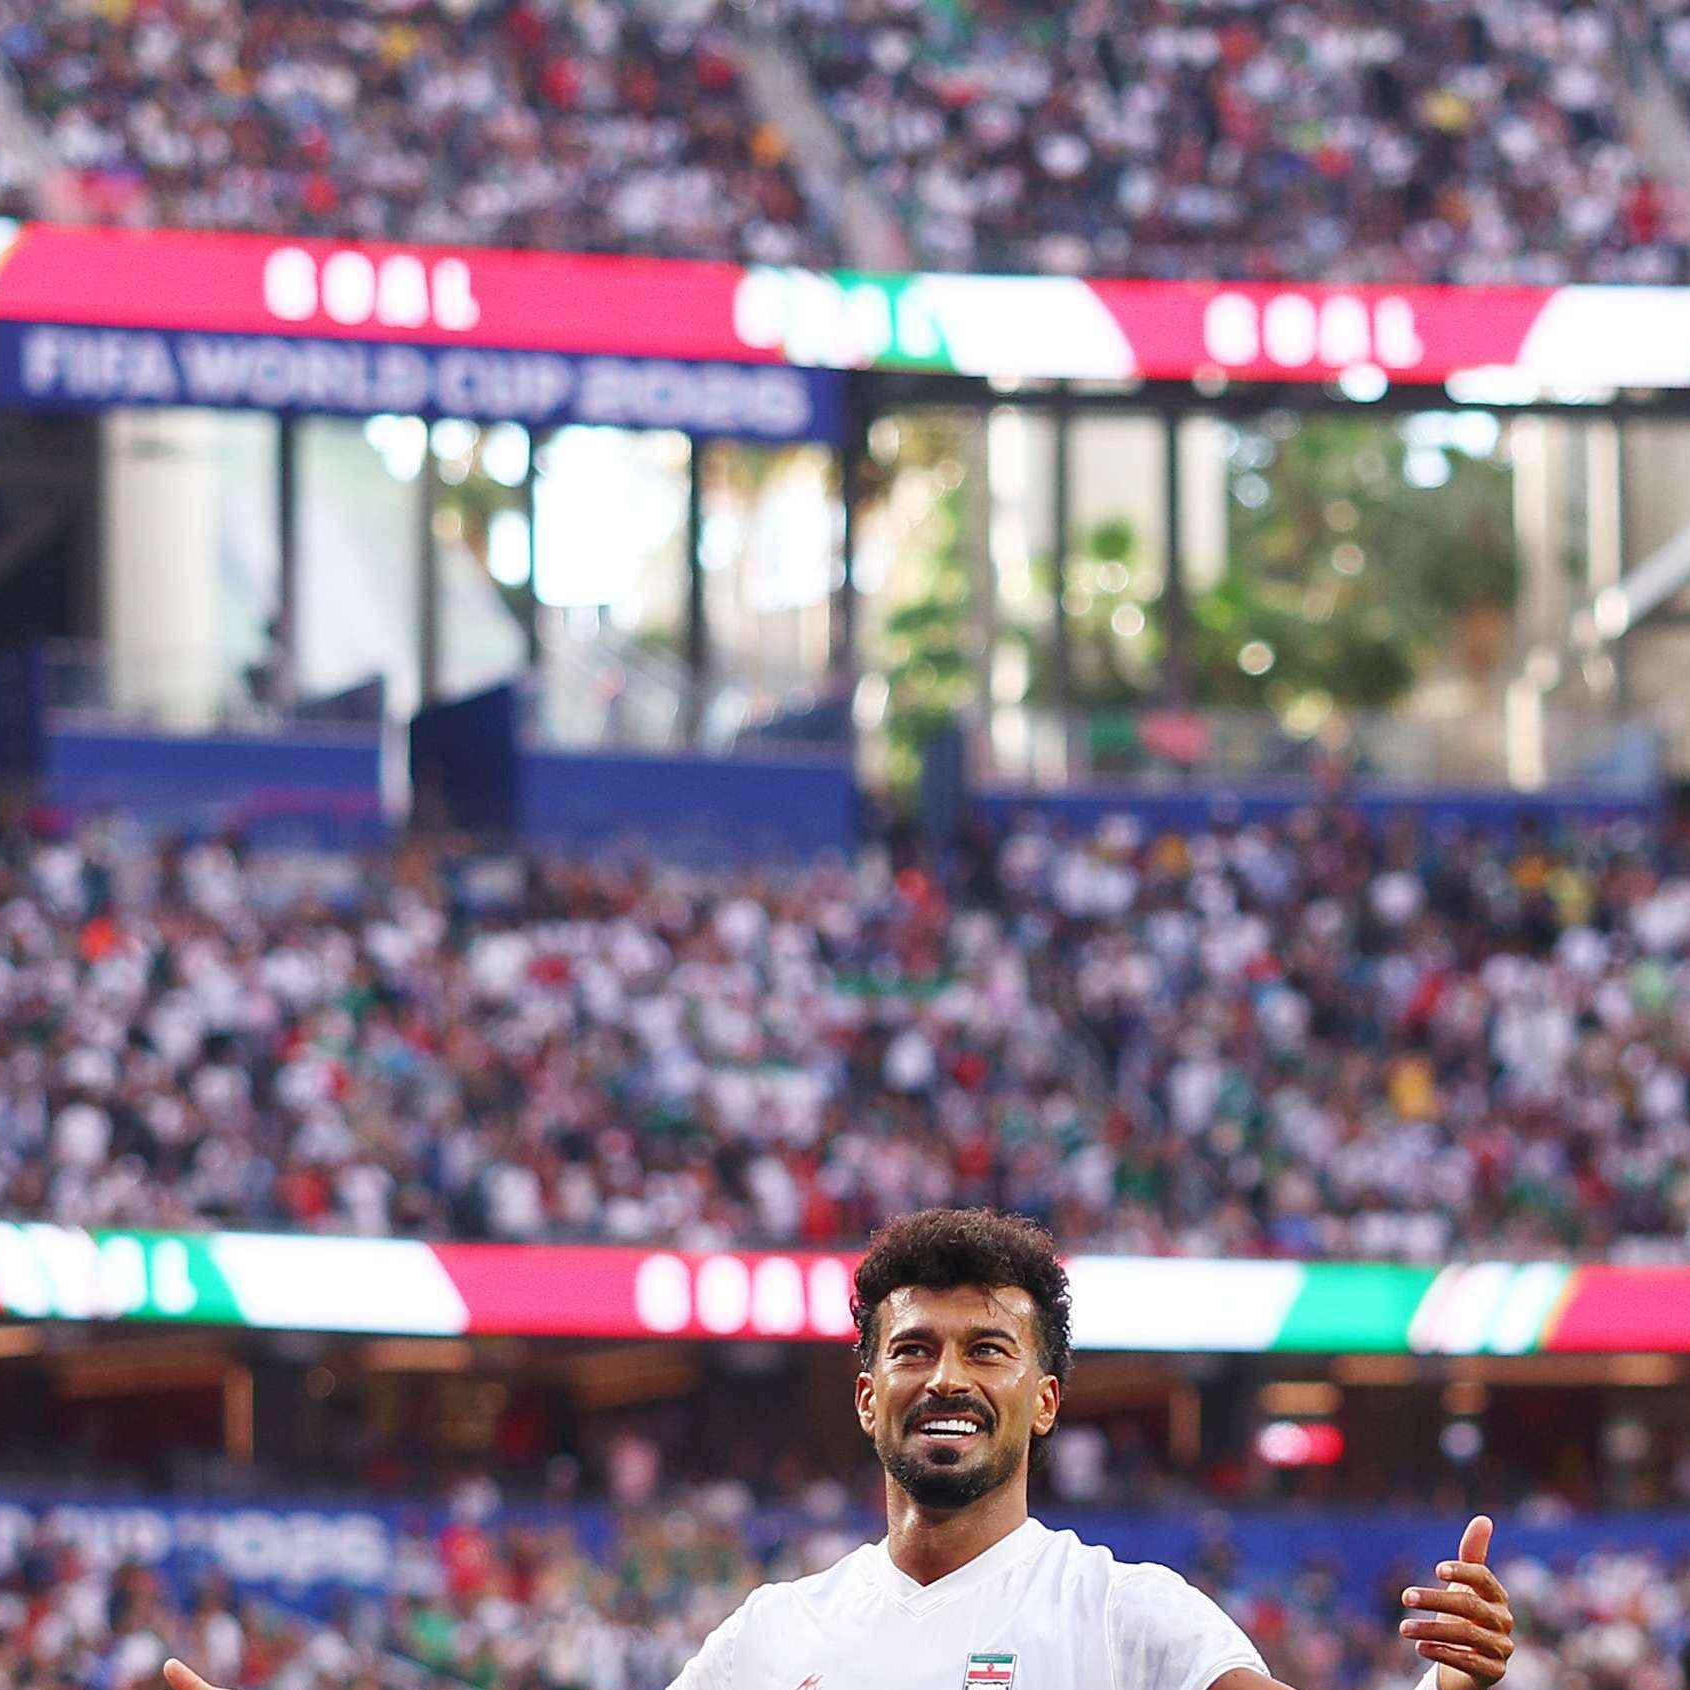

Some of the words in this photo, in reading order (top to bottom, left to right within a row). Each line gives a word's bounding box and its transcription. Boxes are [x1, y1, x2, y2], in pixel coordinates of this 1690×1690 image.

[20, 328, 179, 398] FIFA
[181, 336, 429, 412] WORLD
[435, 348, 571, 420] CUP
